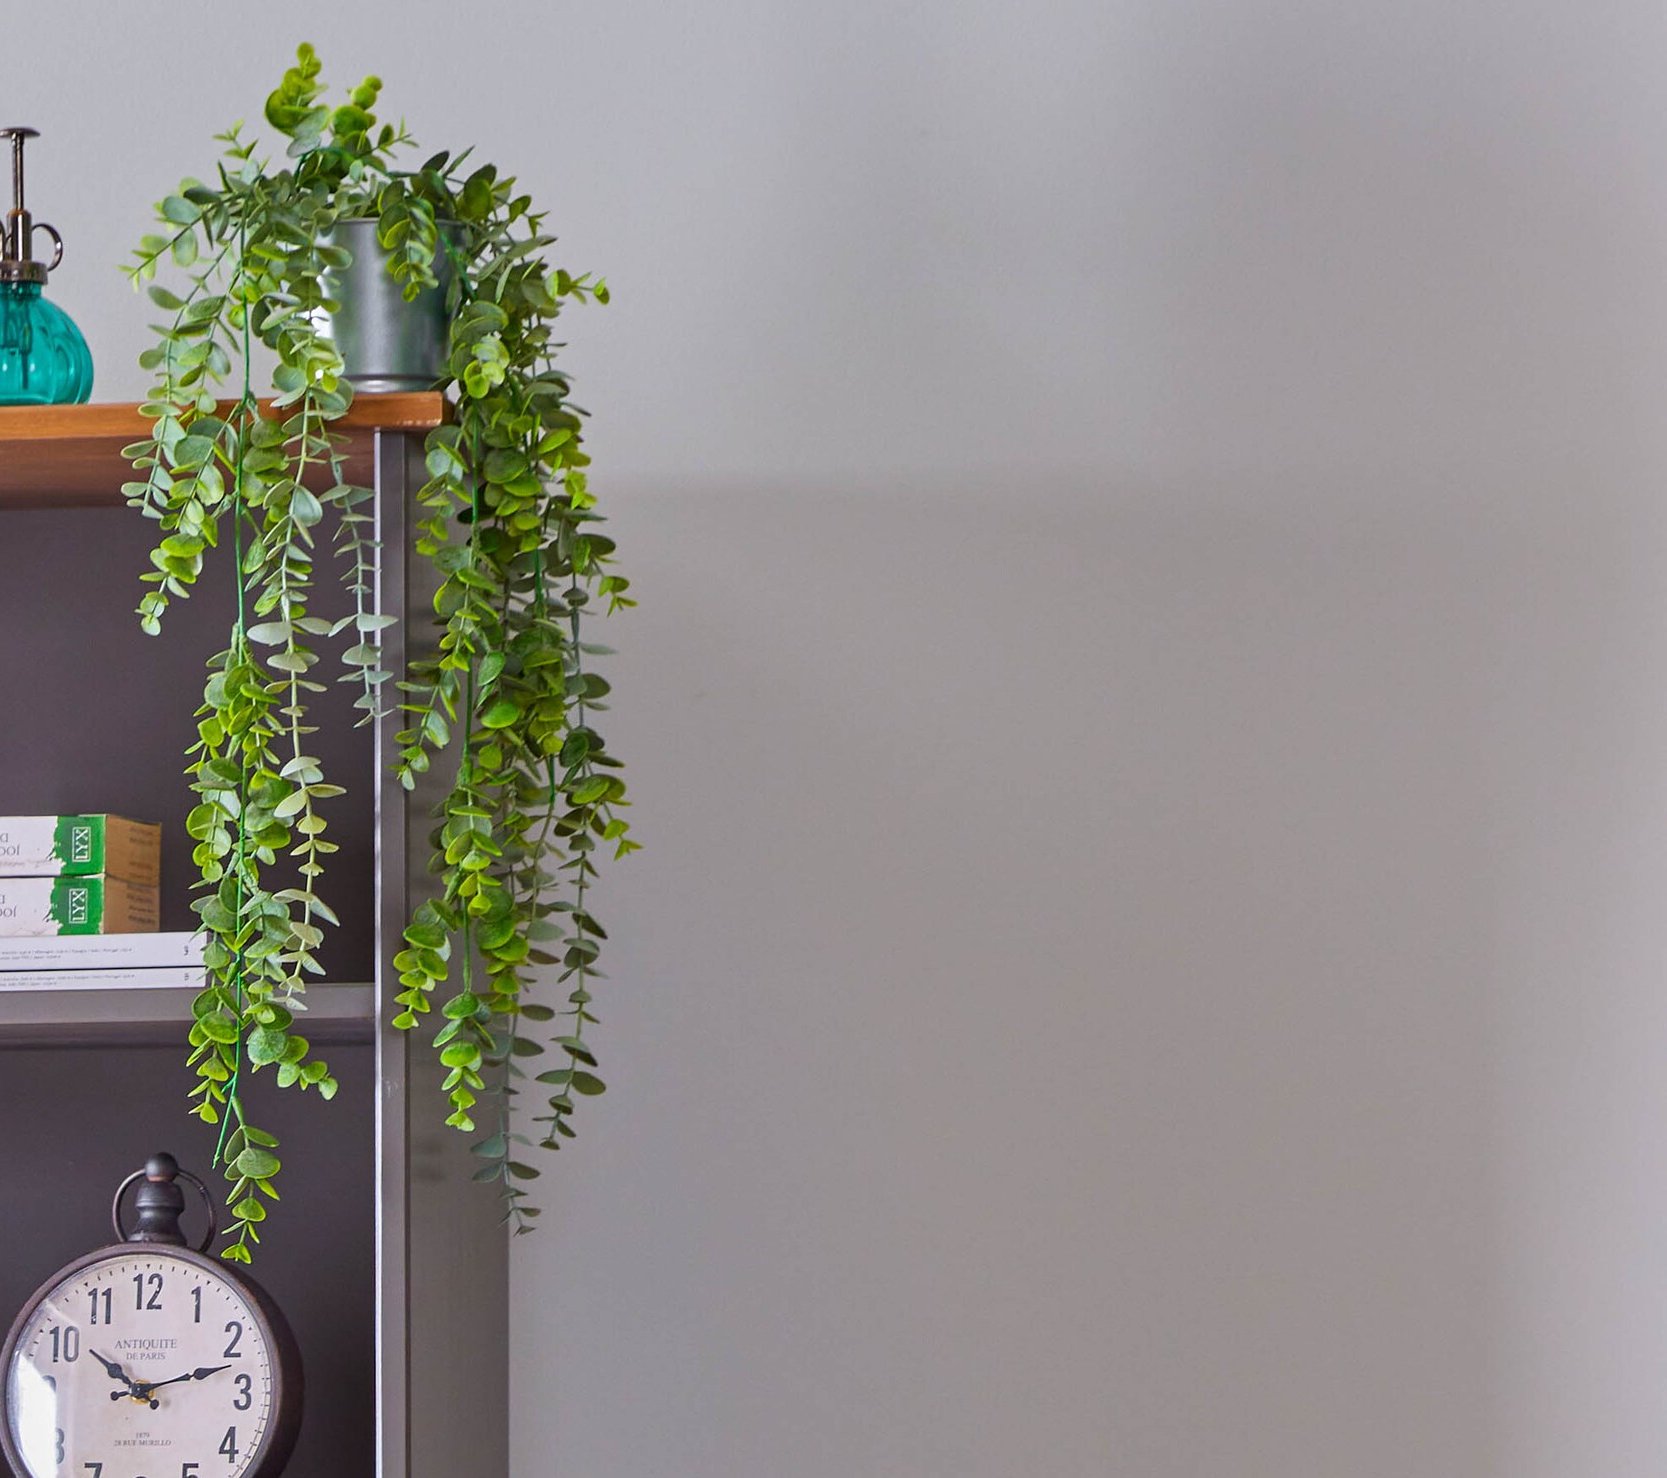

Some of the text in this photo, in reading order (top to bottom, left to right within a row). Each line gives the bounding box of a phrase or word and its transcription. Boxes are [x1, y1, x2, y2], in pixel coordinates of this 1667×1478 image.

[75, 828, 89, 861] LYX
[71, 890, 86, 922] LYX
[88, 1288, 112, 1324] 11
[133, 1273, 163, 1309] 12
[191, 1287, 201, 1323] 1
[50, 1326, 79, 1362] 10
[114, 1339, 177, 1349] ANTIQUITE
[223, 1321, 242, 1358] 2
[234, 1373, 251, 1410] 3
[219, 1427, 238, 1462] 4
